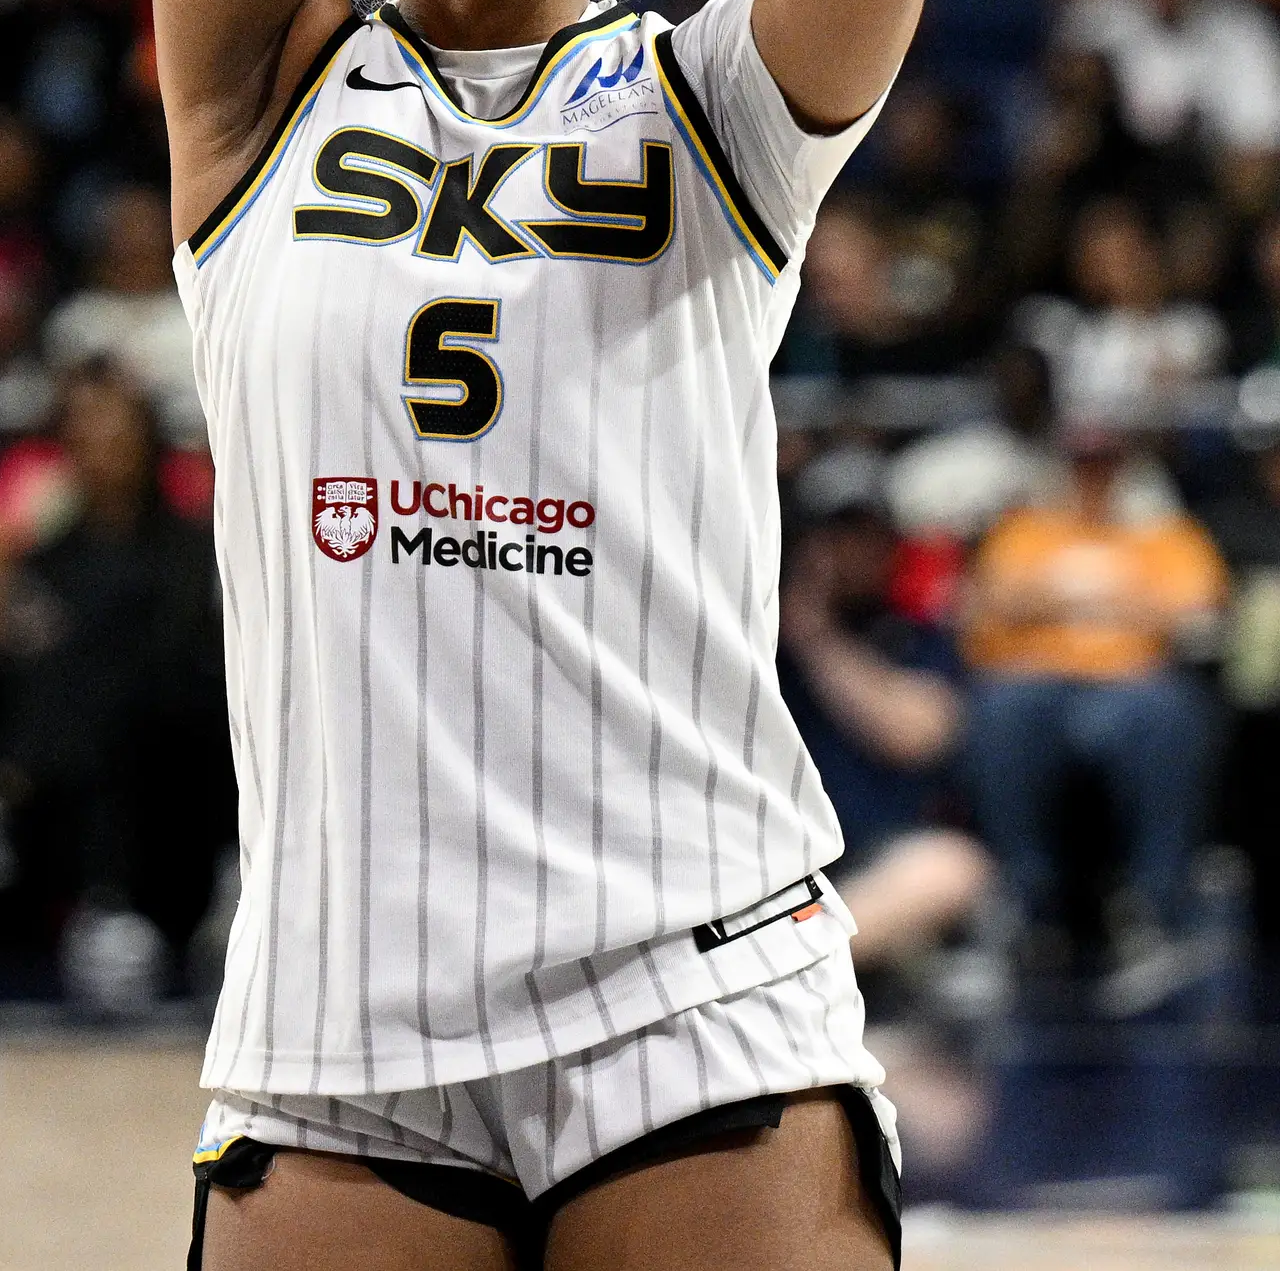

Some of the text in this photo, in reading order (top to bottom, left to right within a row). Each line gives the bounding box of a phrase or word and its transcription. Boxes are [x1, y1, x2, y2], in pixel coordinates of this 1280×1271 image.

[561, 82, 655, 125] MAGELLAN
[293, 123, 674, 266] SKY
[400, 295, 505, 443] 5
[390, 480, 596, 534] UChicago
[390, 526, 594, 577] Medicine
